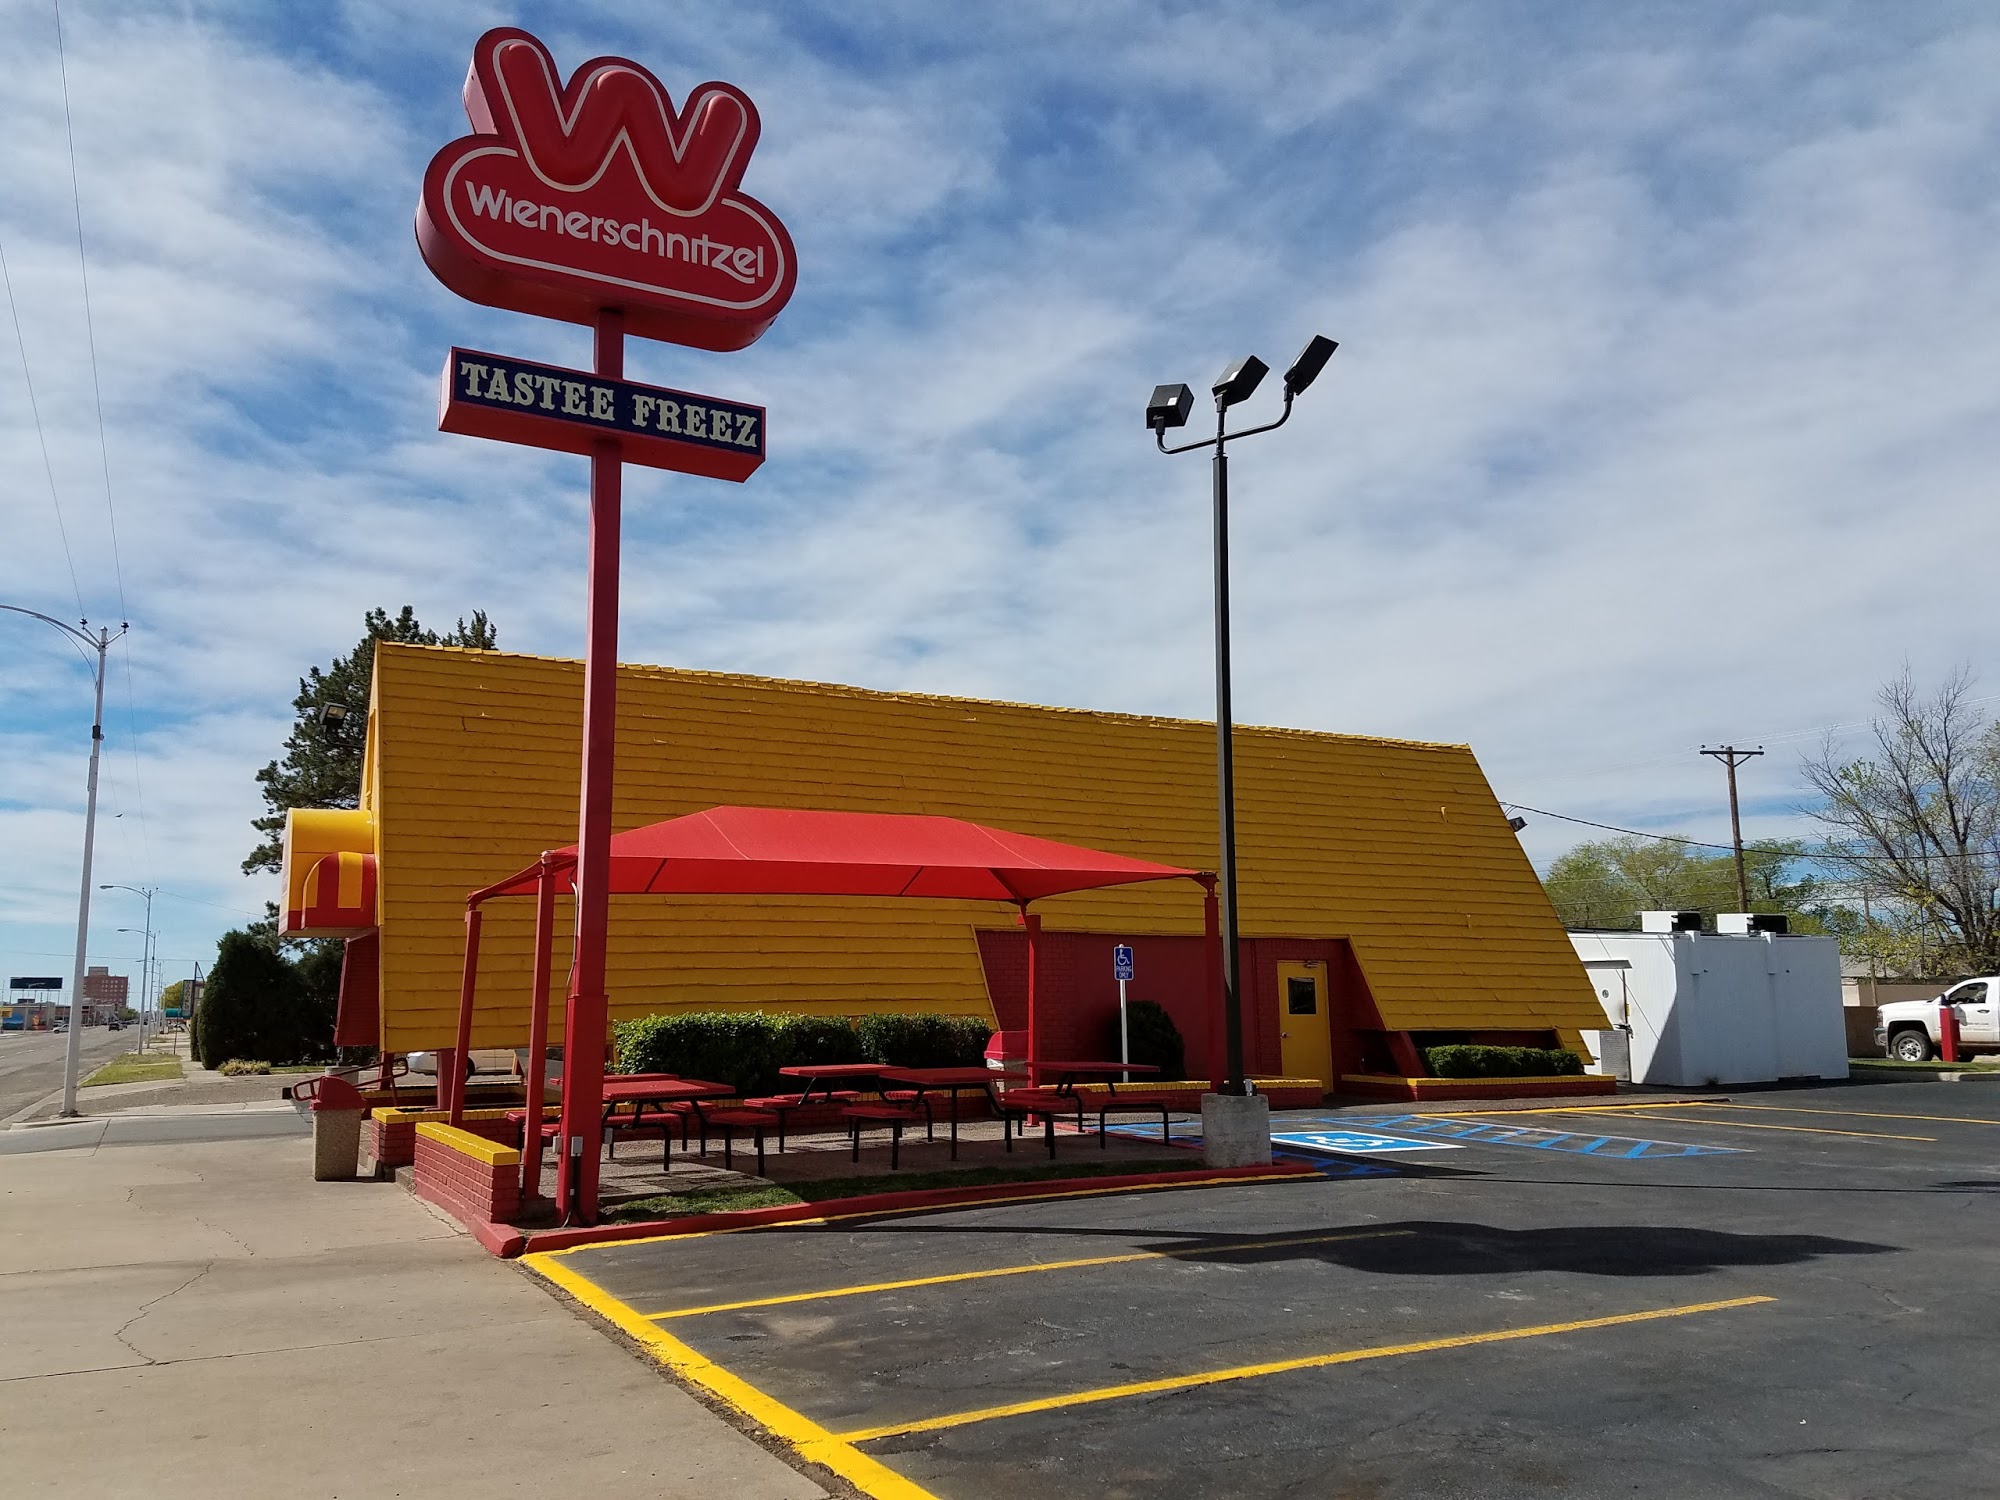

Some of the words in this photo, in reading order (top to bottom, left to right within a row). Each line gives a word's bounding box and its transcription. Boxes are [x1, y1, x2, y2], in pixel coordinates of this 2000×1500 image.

[464, 180, 765, 284] Wienerschnitzel
[461, 361, 616, 422] TASTEE
[631, 394, 758, 448] FREEZ
